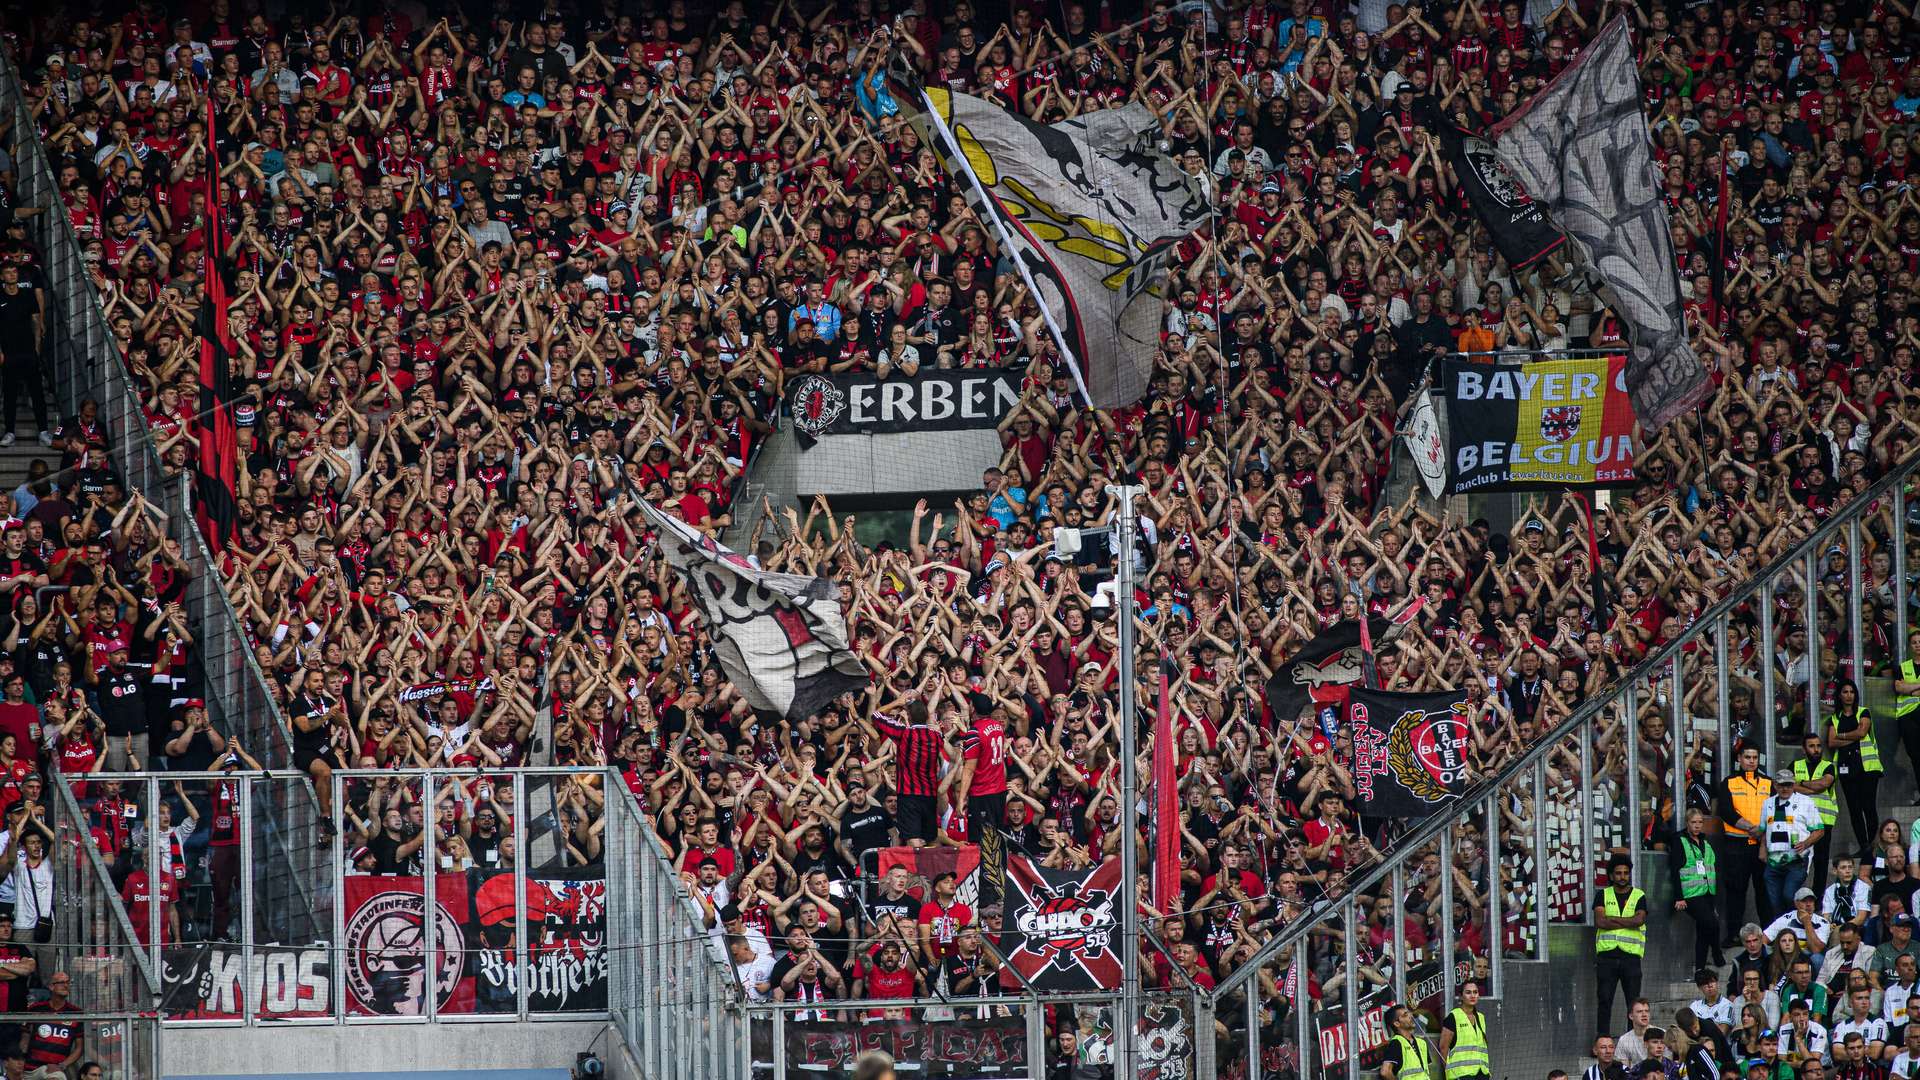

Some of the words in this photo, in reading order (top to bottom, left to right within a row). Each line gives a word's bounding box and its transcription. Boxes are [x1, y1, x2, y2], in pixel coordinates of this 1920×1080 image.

[1457, 371, 1600, 400] BAYER
[122, 684, 136, 695] LG
[991, 736, 1003, 765] 11
[1351, 703, 1373, 802] JUGEND
[1370, 727, 1388, 776] LEV
[1437, 724, 1456, 767] BAYER
[347, 898, 443, 998] FARBENSTADTINFERO
[1086, 932, 1110, 948] 513
[53, 1028, 69, 1039] LG
